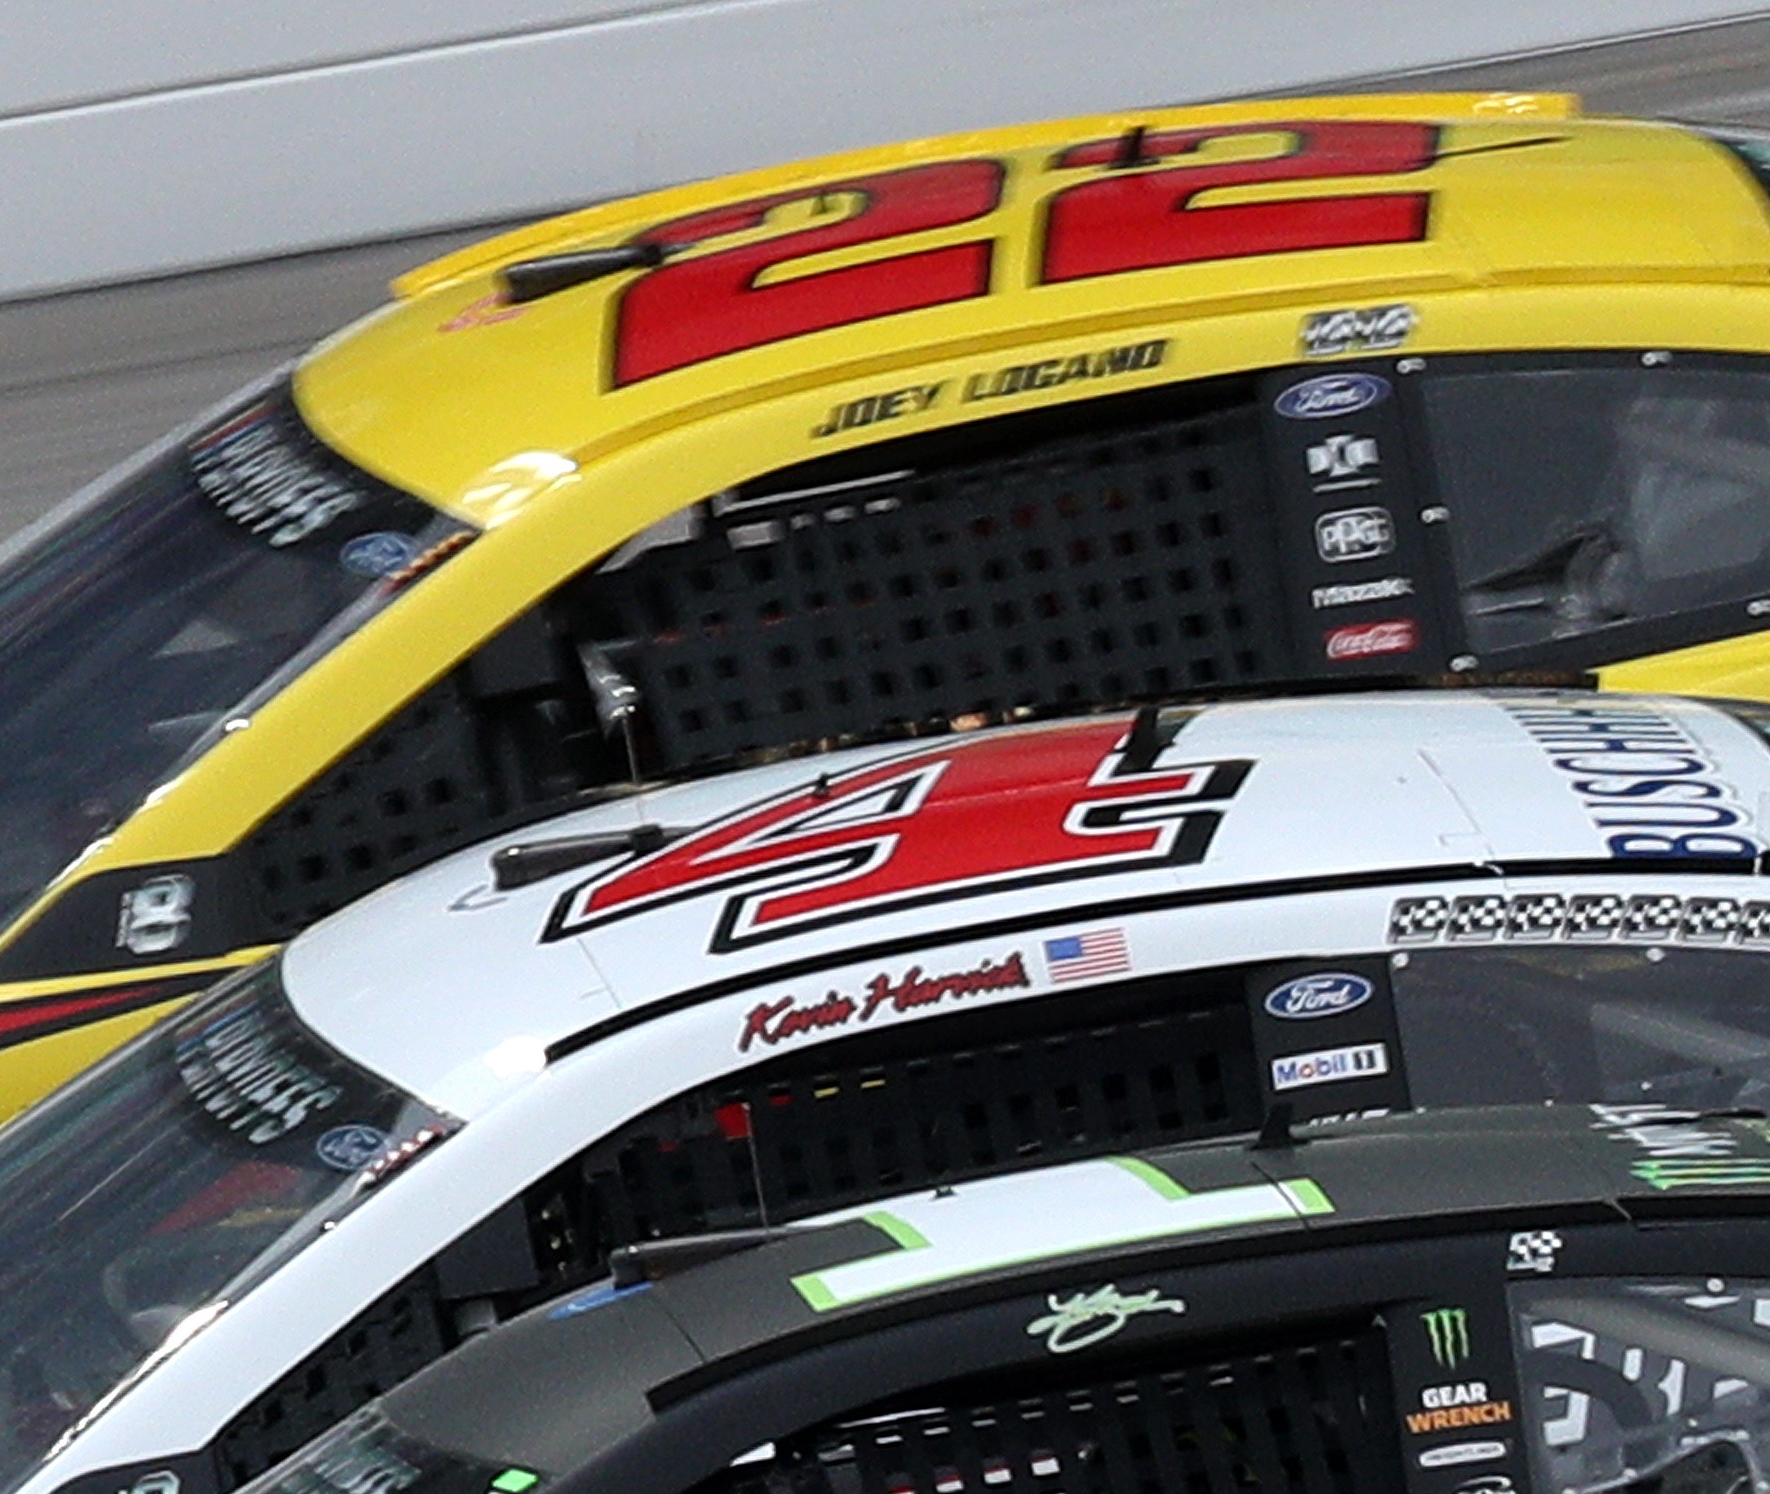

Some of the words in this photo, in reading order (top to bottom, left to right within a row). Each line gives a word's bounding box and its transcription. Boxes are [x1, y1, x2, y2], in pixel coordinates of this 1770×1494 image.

[603, 119, 1441, 394] 22
[810, 379, 947, 438] JOEY
[963, 339, 1172, 403] LOGANO
[540, 714, 1256, 953] 4
[1276, 1053, 1347, 1082] Mobil
[1406, 1401, 1511, 1433] WRENCH
[1422, 1382, 1487, 1408] GEAR
